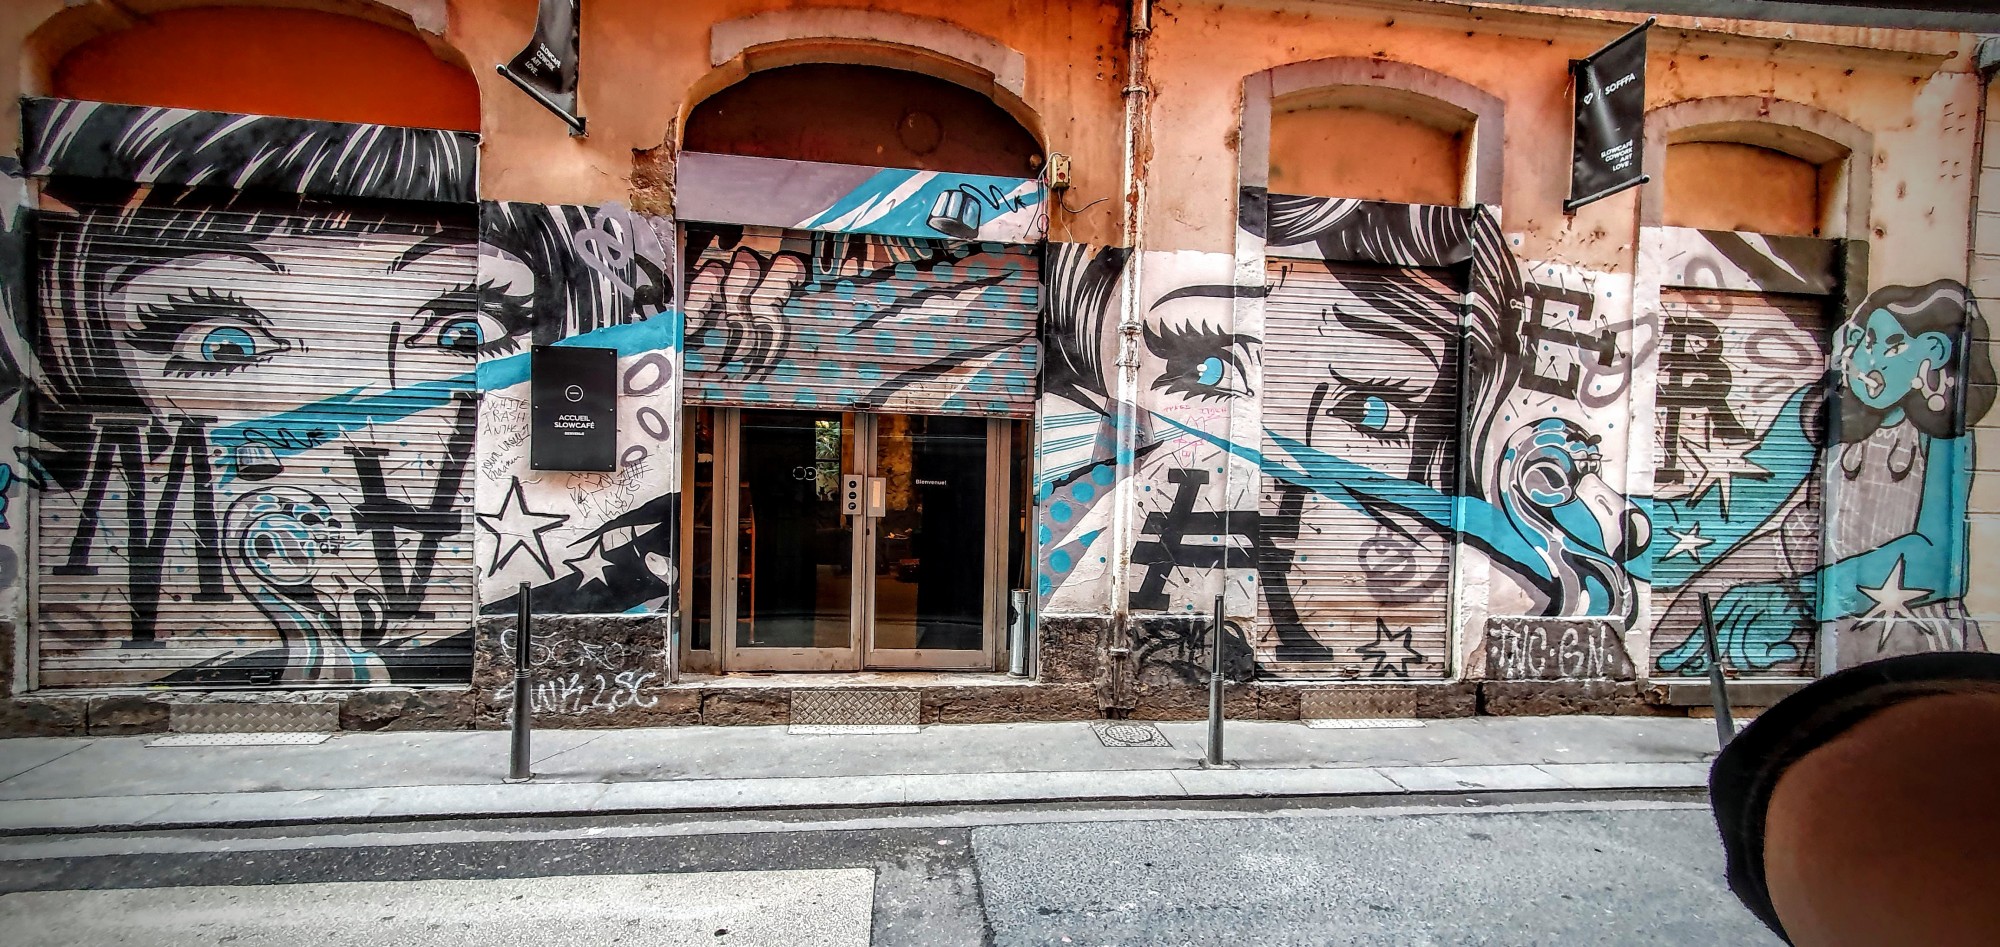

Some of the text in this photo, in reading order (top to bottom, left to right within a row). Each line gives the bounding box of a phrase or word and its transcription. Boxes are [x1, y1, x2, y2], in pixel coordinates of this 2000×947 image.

[536, 50, 555, 71] COWORK
[1605, 73, 1636, 95] SOFFFA
[1605, 147, 1633, 162] COWORK
[1619, 153, 1633, 162] ART
[481, 409, 526, 423] TRASH
[559, 414, 591, 422] ACCUEIL
[554, 421, 595, 429] SLOWCAFÉ
